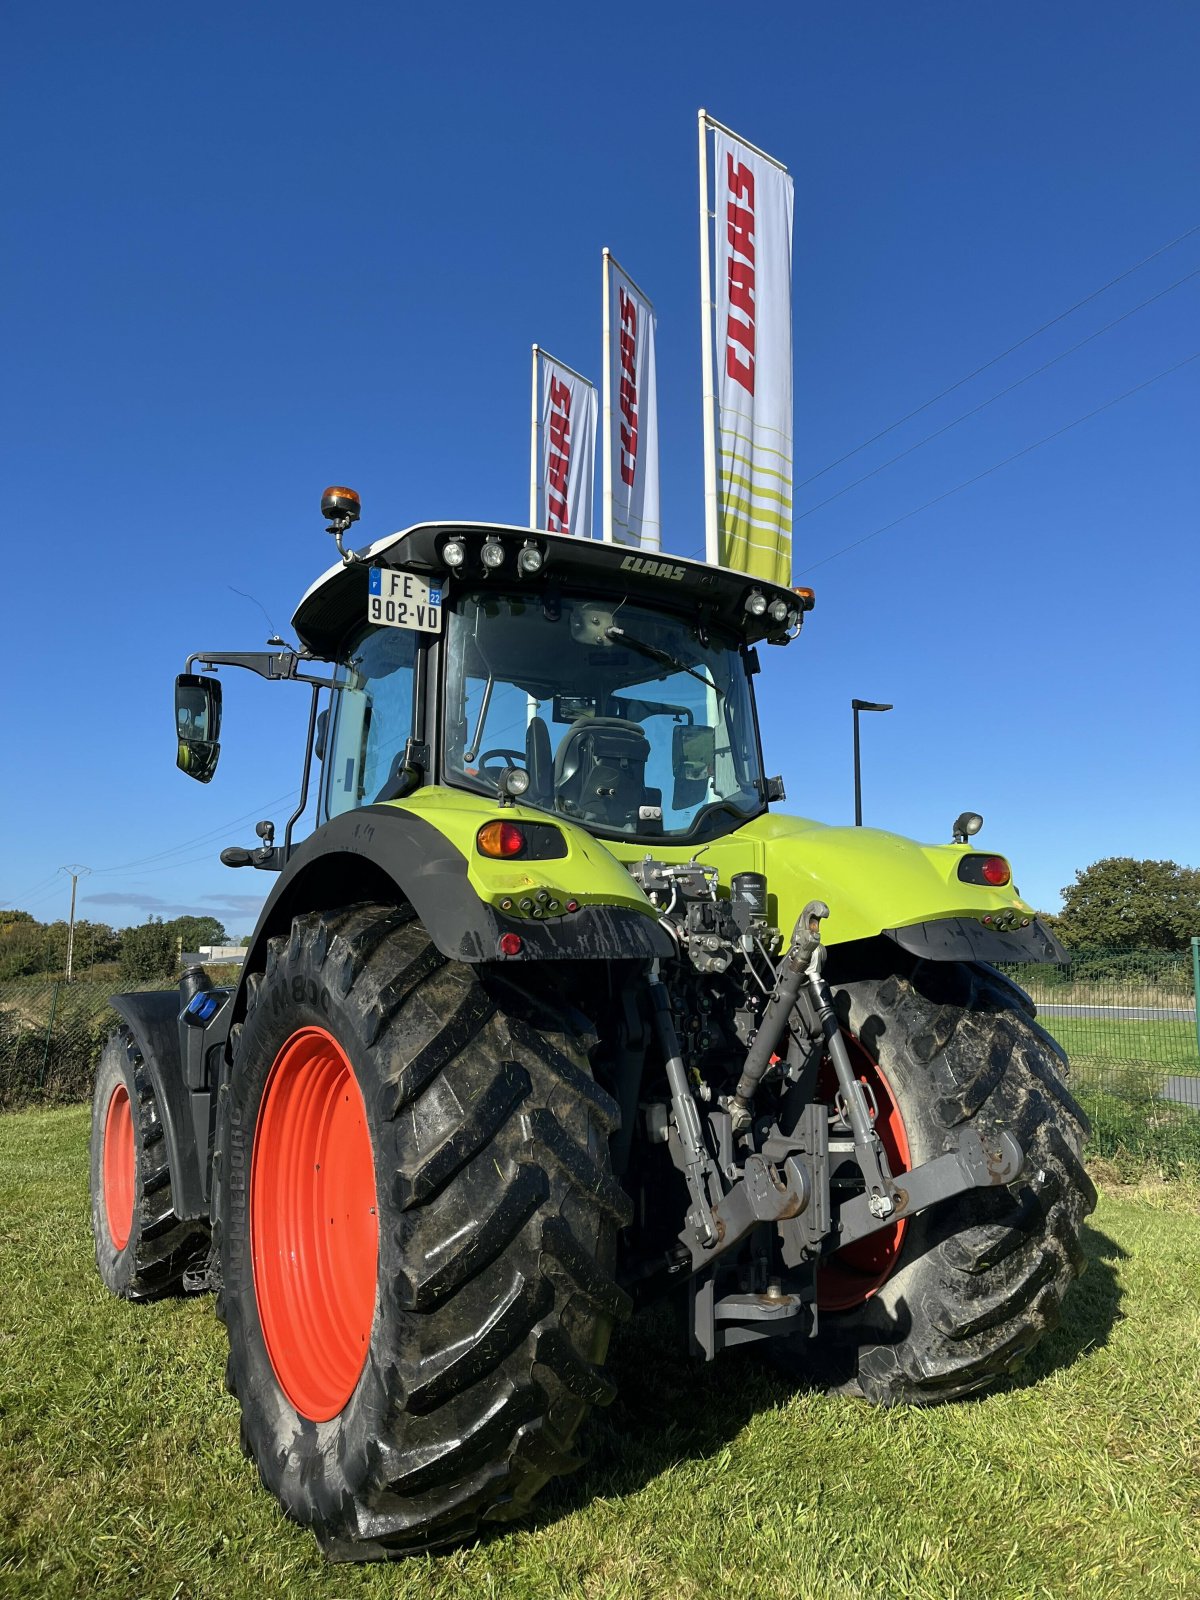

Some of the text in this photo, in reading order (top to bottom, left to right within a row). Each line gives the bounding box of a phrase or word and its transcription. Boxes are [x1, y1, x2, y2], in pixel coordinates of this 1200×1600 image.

[727, 152, 755, 397] CLAAS
[620, 286, 638, 488] CLAAS
[620, 555, 687, 581] CLAAS
[372, 598, 437, 628] 902-VD
[430, 594, 440, 604] 22
